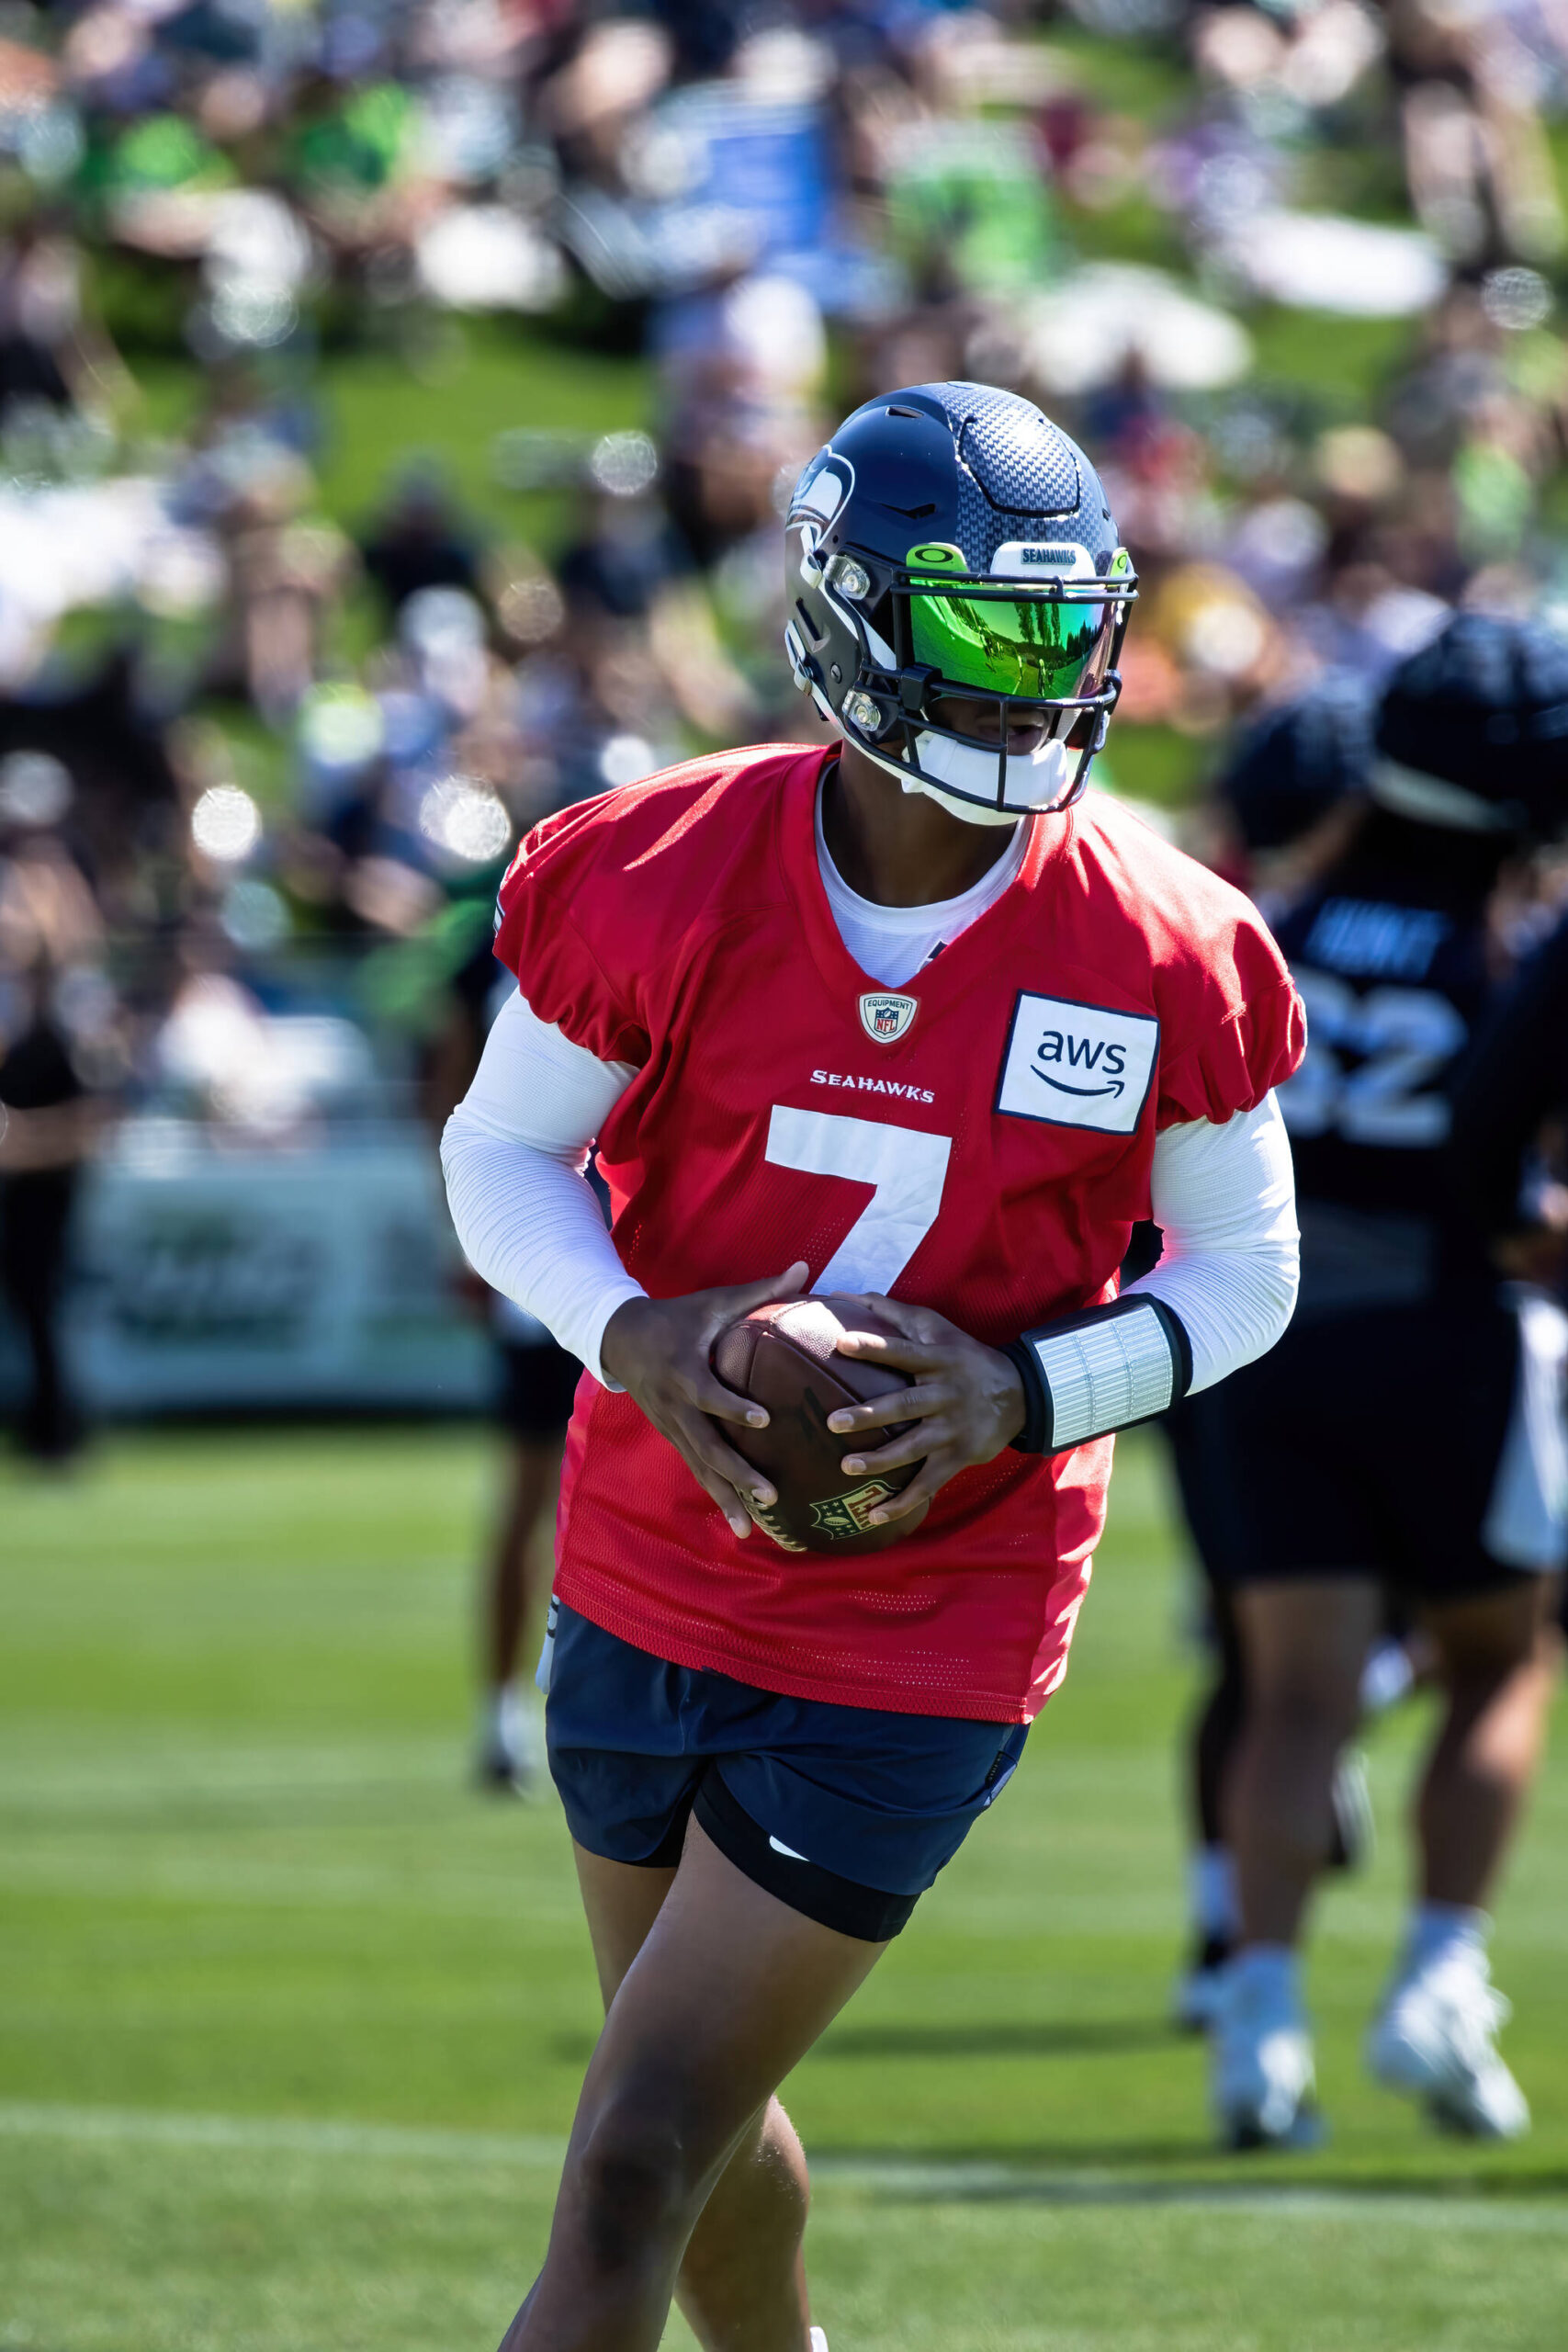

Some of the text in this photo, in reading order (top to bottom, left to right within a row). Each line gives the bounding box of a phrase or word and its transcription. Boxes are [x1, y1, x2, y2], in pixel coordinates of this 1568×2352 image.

[1021, 548, 1077, 563] SEAHAWKS
[867, 999, 910, 1011] EQUIPMENT
[876, 1018, 897, 1032] NFL
[1037, 1030, 1127, 1075] aws
[764, 1104, 953, 1296] 7
